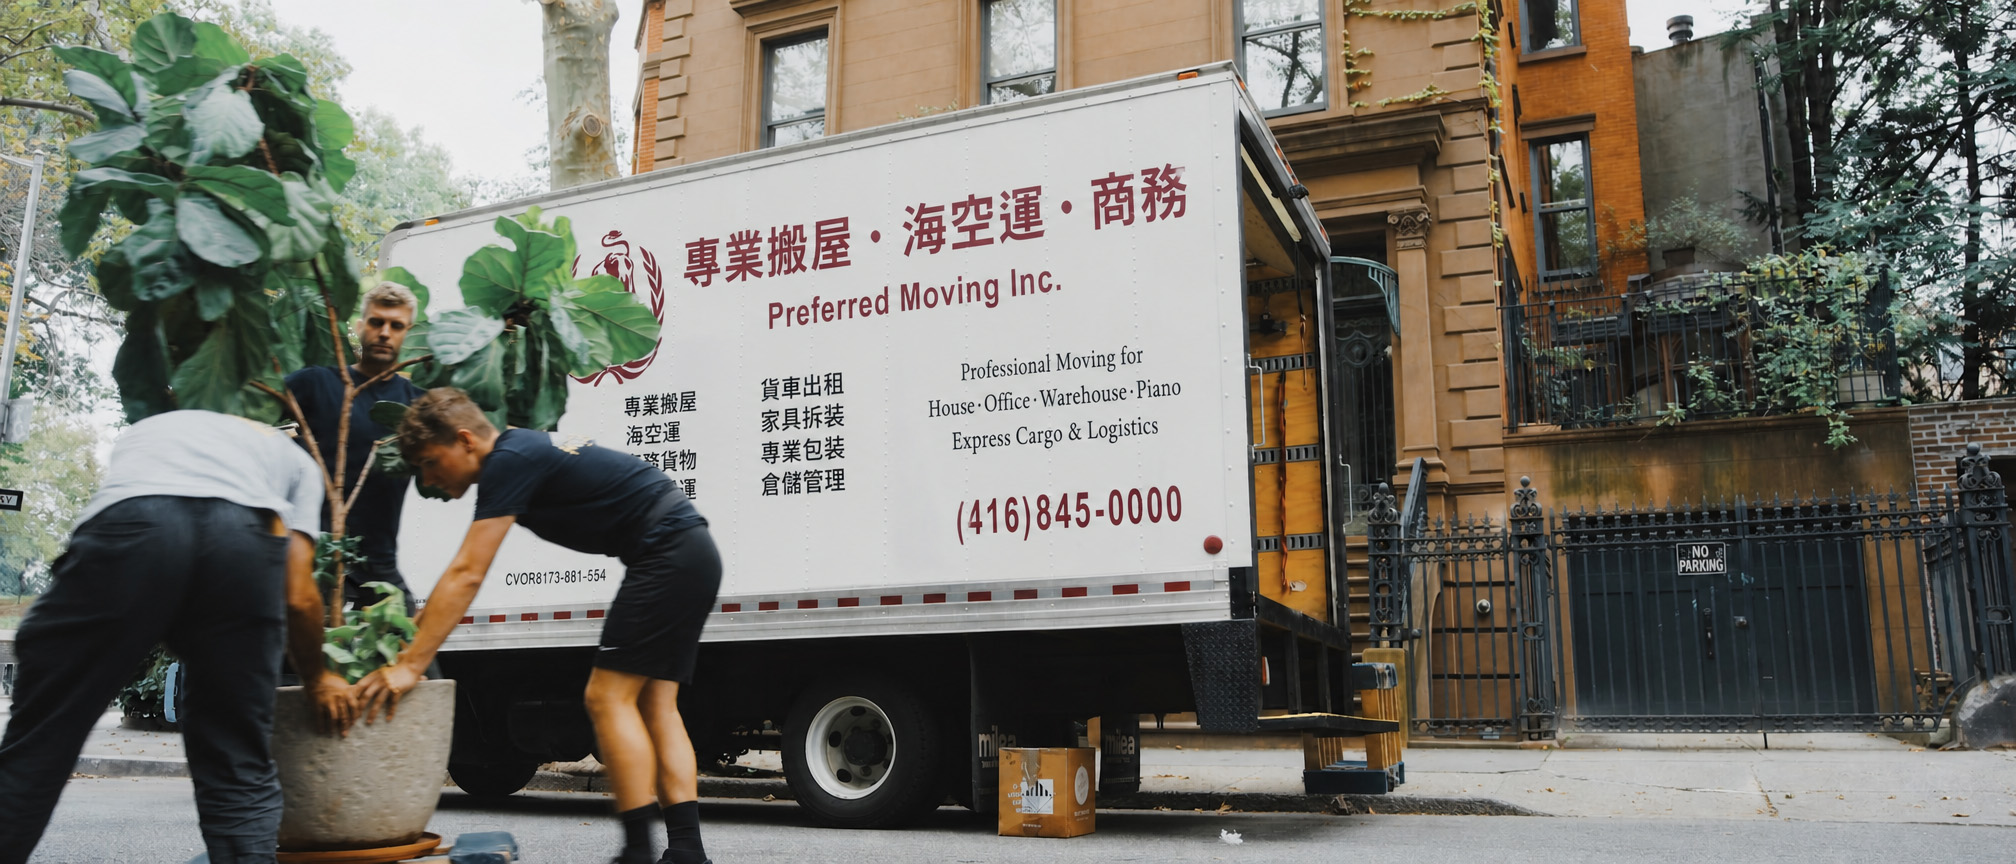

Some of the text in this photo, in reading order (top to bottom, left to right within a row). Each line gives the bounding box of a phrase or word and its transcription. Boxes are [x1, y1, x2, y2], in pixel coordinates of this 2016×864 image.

[769, 269, 1061, 329] Preferred Moving Inc.
[961, 346, 1143, 381] Professional Moving for
[761, 372, 844, 402] 貨車出租
[627, 421, 680, 446] 海空運
[953, 417, 1158, 454] Express Cargo & Logistics
[762, 468, 845, 496] 倉儲管理
[957, 486, 1181, 545] (416)845-0000
[1679, 558, 1724, 572] PARKING
[1692, 545, 1709, 558] NO
[506, 569, 606, 585] CVOR8173-881-554
